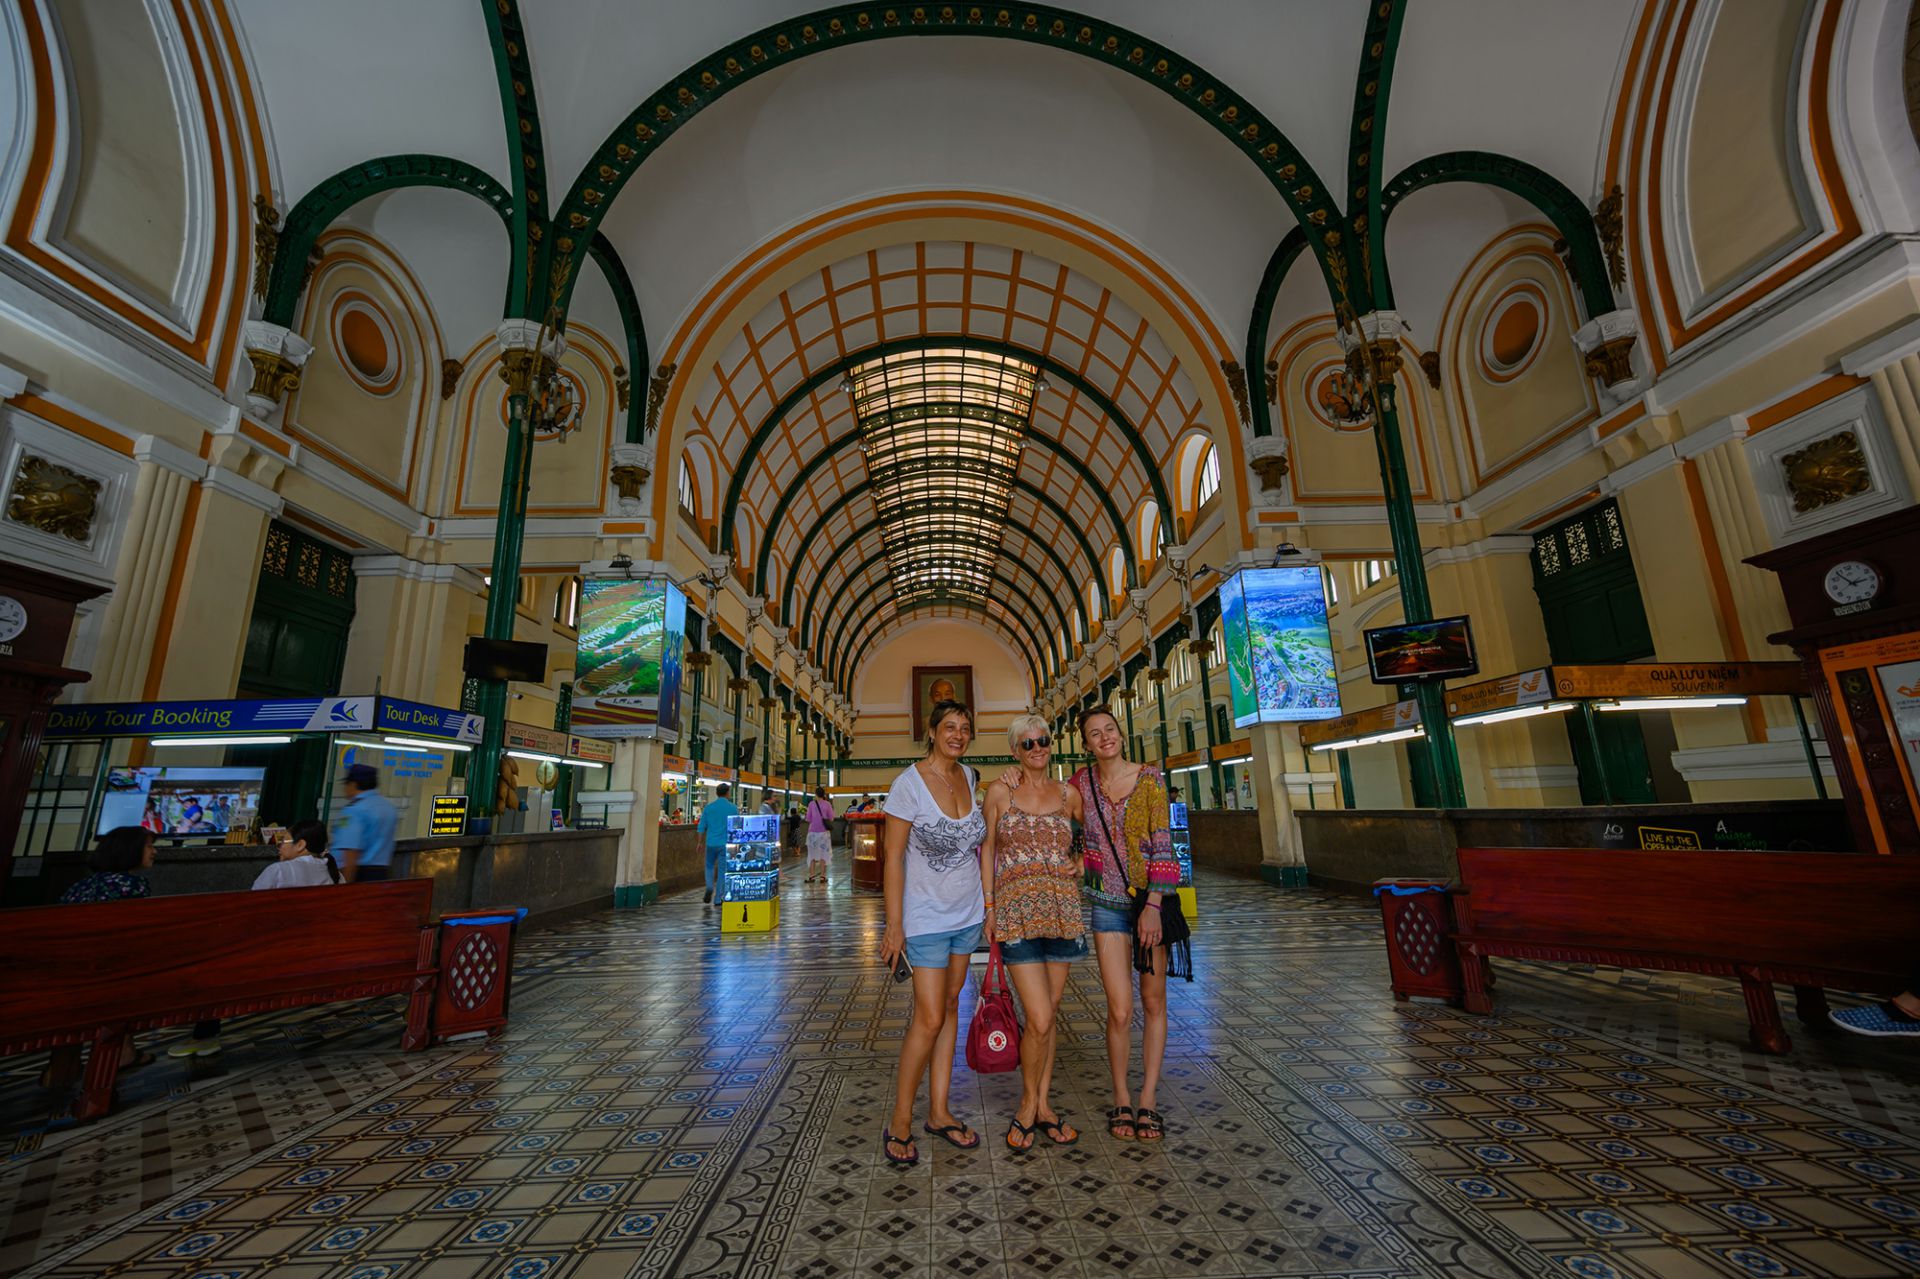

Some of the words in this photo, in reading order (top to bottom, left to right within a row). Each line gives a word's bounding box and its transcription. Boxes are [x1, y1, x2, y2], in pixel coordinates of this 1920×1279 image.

[1671, 682, 1725, 692] SOUVENIR
[48, 710, 97, 731] Daily
[104, 709, 145, 727] Tour
[151, 707, 232, 728] Booking
[386, 704, 410, 722] Tour
[413, 710, 439, 727] Desk
[1646, 833, 1664, 843] LIVE
[1677, 836, 1693, 846] THE
